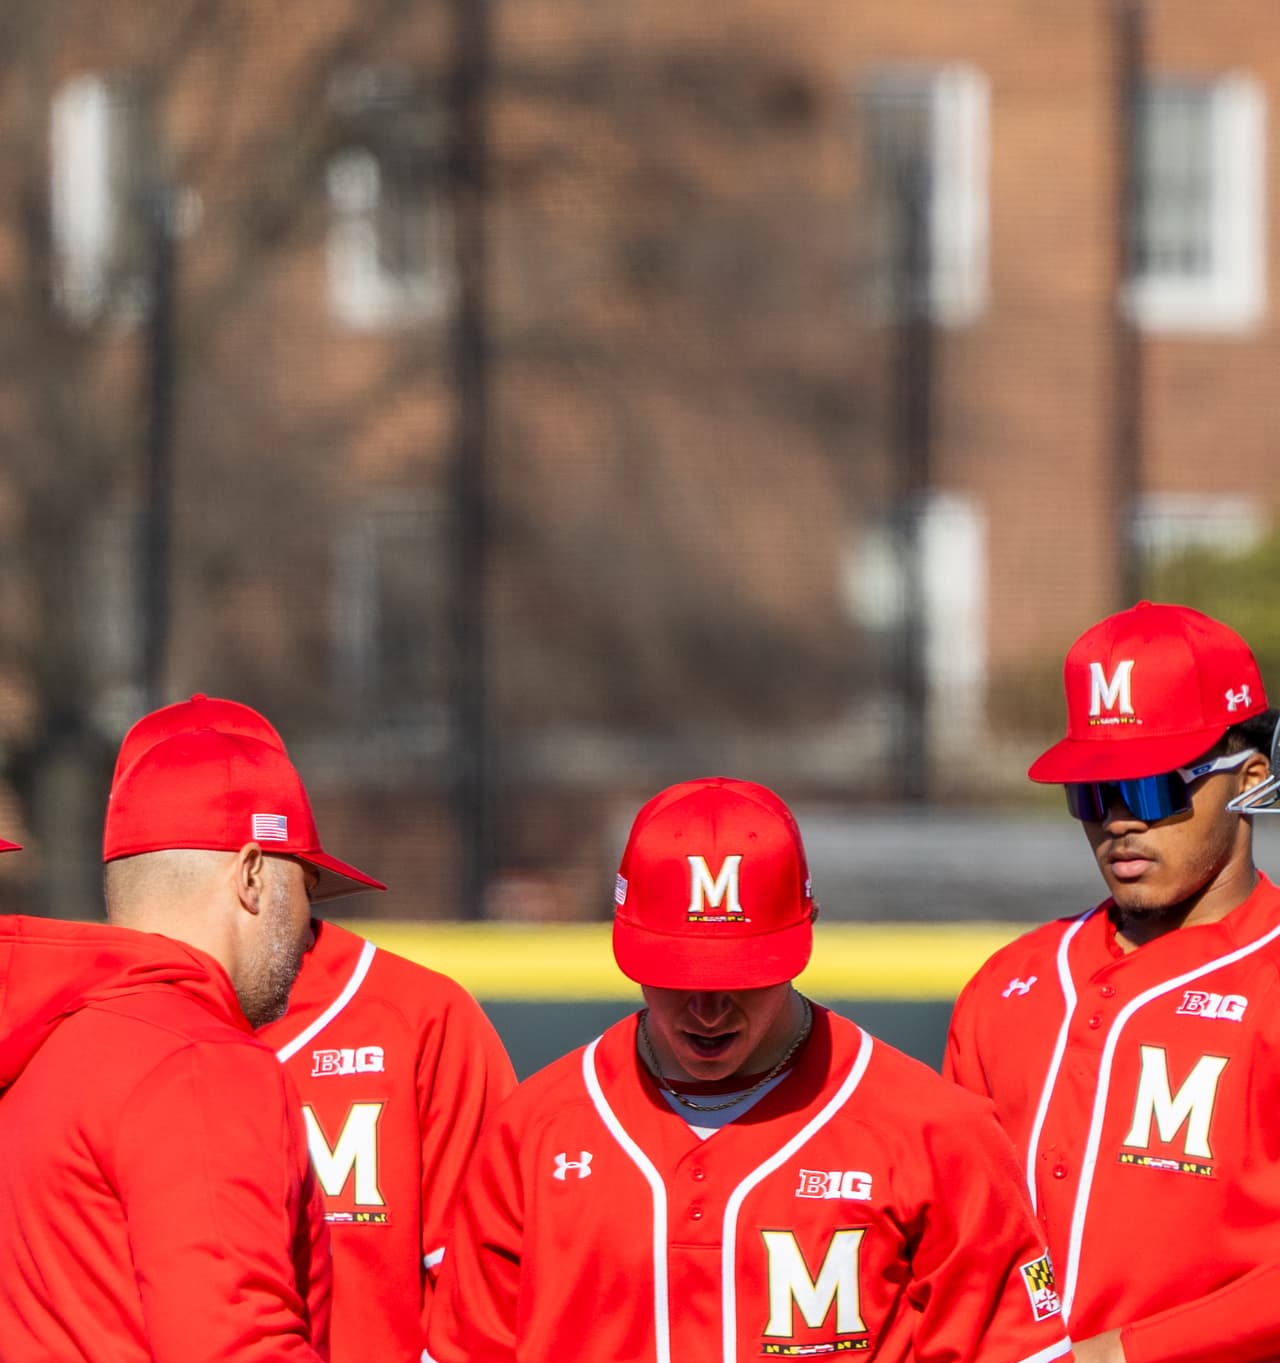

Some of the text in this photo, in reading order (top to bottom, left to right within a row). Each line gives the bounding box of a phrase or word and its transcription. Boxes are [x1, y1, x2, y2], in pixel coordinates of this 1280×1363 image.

[1089, 660, 1135, 716] M
[687, 855, 743, 913] M
[1122, 1044, 1231, 1159] M
[302, 1102, 386, 1206] M
[760, 1228, 868, 1338] M
